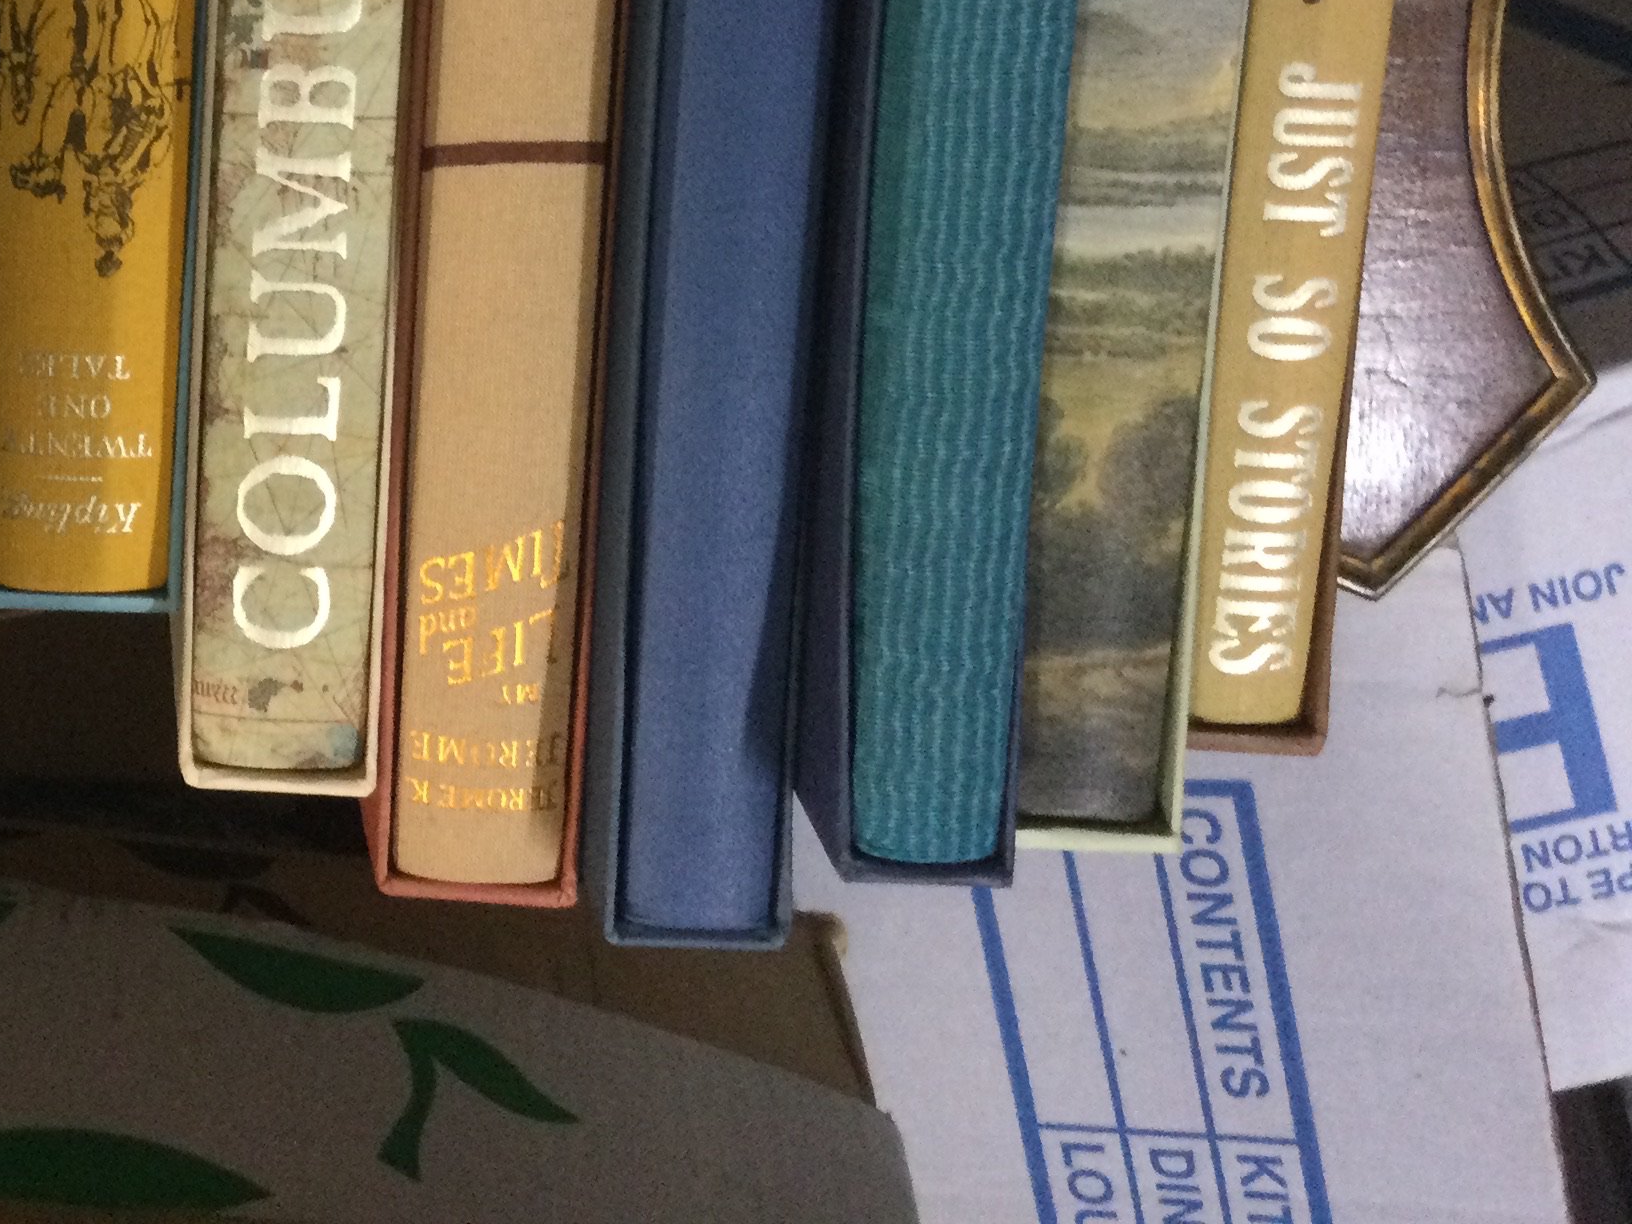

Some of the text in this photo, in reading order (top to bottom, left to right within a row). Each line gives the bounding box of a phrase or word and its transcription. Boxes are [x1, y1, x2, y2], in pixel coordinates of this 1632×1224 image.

[16, 353, 131, 381] TALES
[1208, 61, 1362, 677] JUST SO STORIES
[38, 394, 112, 421] ONE
[2, 495, 142, 537] Kipling
[418, 521, 572, 605] TIMES
[1528, 562, 1626, 613] JOIN
[418, 606, 477, 656] and
[442, 607, 557, 686] LIFE
[500, 682, 539, 706] MY
[409, 729, 562, 769] JEROME
[437, 783, 560, 813] JEROME
[1523, 874, 1582, 914] TO
[1180, 807, 1270, 1099] CONTENTS
[1236, 1154, 1293, 1224] KIT
